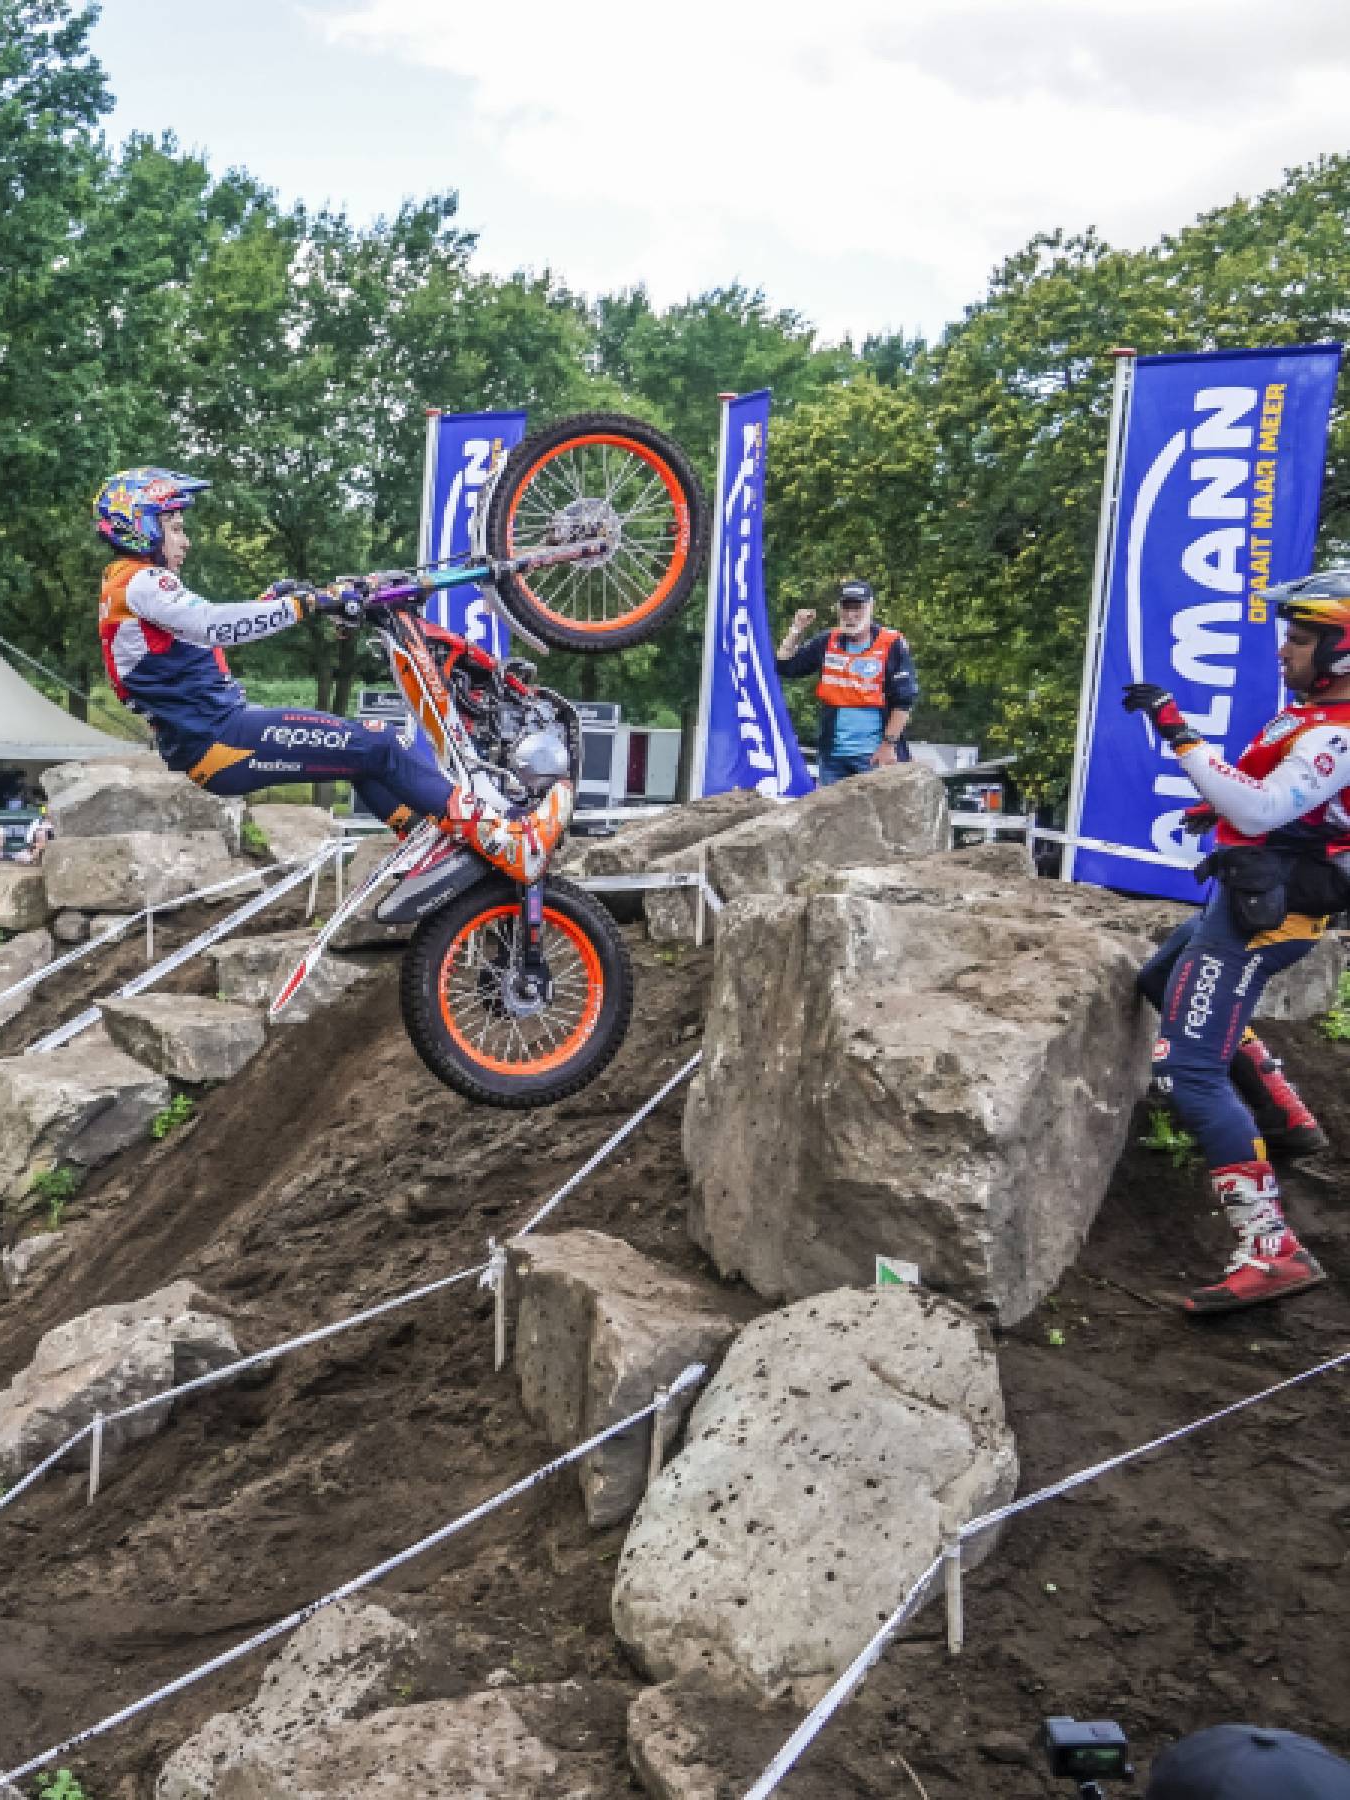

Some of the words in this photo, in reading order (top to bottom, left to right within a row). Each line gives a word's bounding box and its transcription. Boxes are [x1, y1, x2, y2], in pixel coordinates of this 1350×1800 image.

[1257, 384, 1288, 452] MEER
[1251, 459, 1278, 528] NAAR
[206, 600, 290, 643] repsol
[261, 725, 352, 751] repsol
[1183, 953, 1225, 1039] repsol
